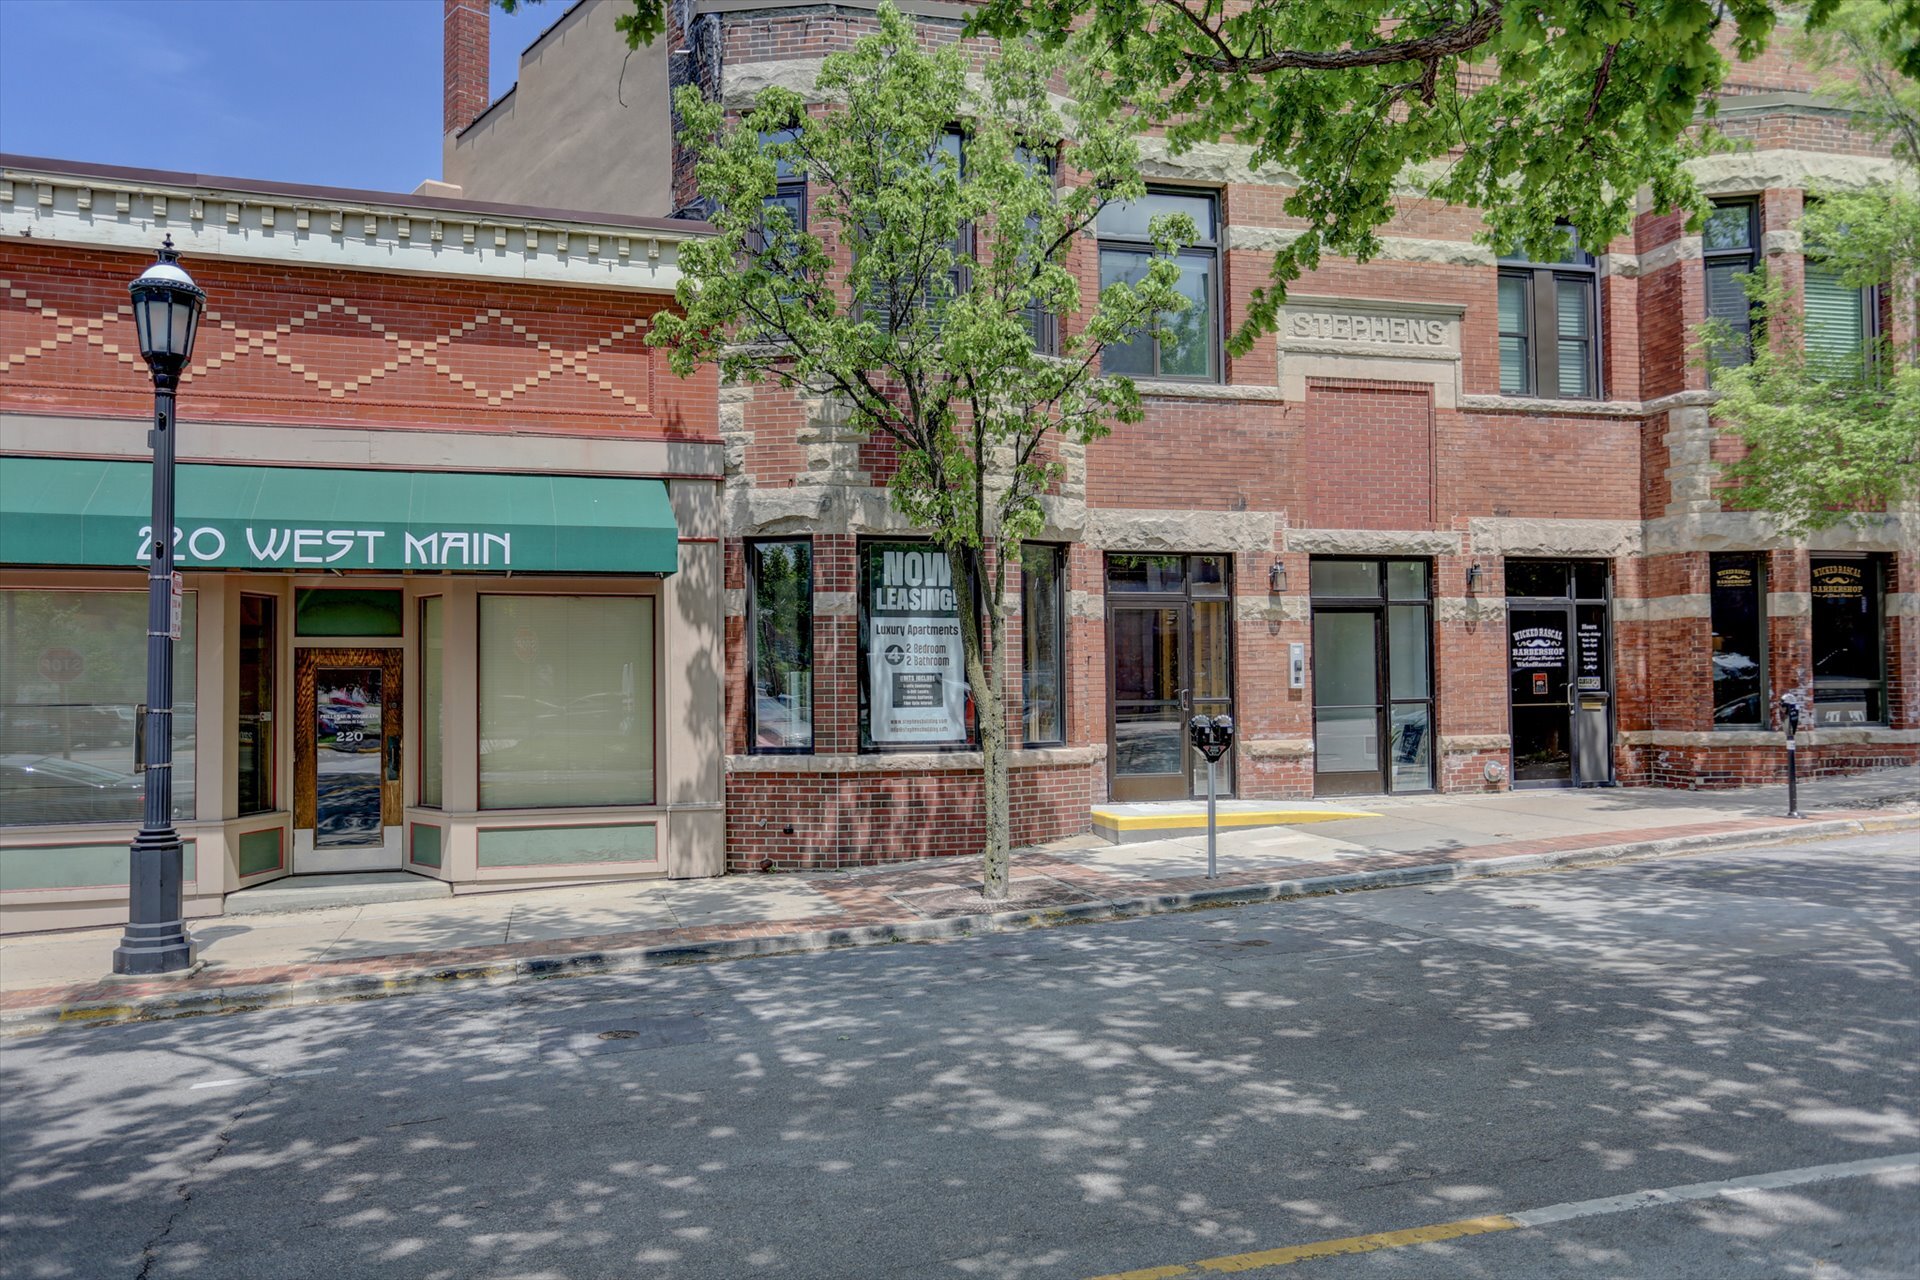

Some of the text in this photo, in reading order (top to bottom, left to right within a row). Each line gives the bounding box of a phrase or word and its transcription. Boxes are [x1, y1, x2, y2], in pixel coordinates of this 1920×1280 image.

[1293, 312, 1443, 344] STEPHENS
[136, 526, 510, 565] 220 WEST MAIN
[883, 551, 951, 587] NOW
[1813, 566, 1861, 577] WICKED RASCAL
[876, 588, 958, 610] LEASING!
[876, 624, 959, 636] Luxury Apartments
[1512, 628, 1562, 640] WICKED RASCAL
[906, 643, 946, 654] 2 Bedroom
[1512, 648, 1565, 656] BARBERSHOP
[906, 656, 950, 666] 2 Bathroom
[336, 731, 363, 742] 220
